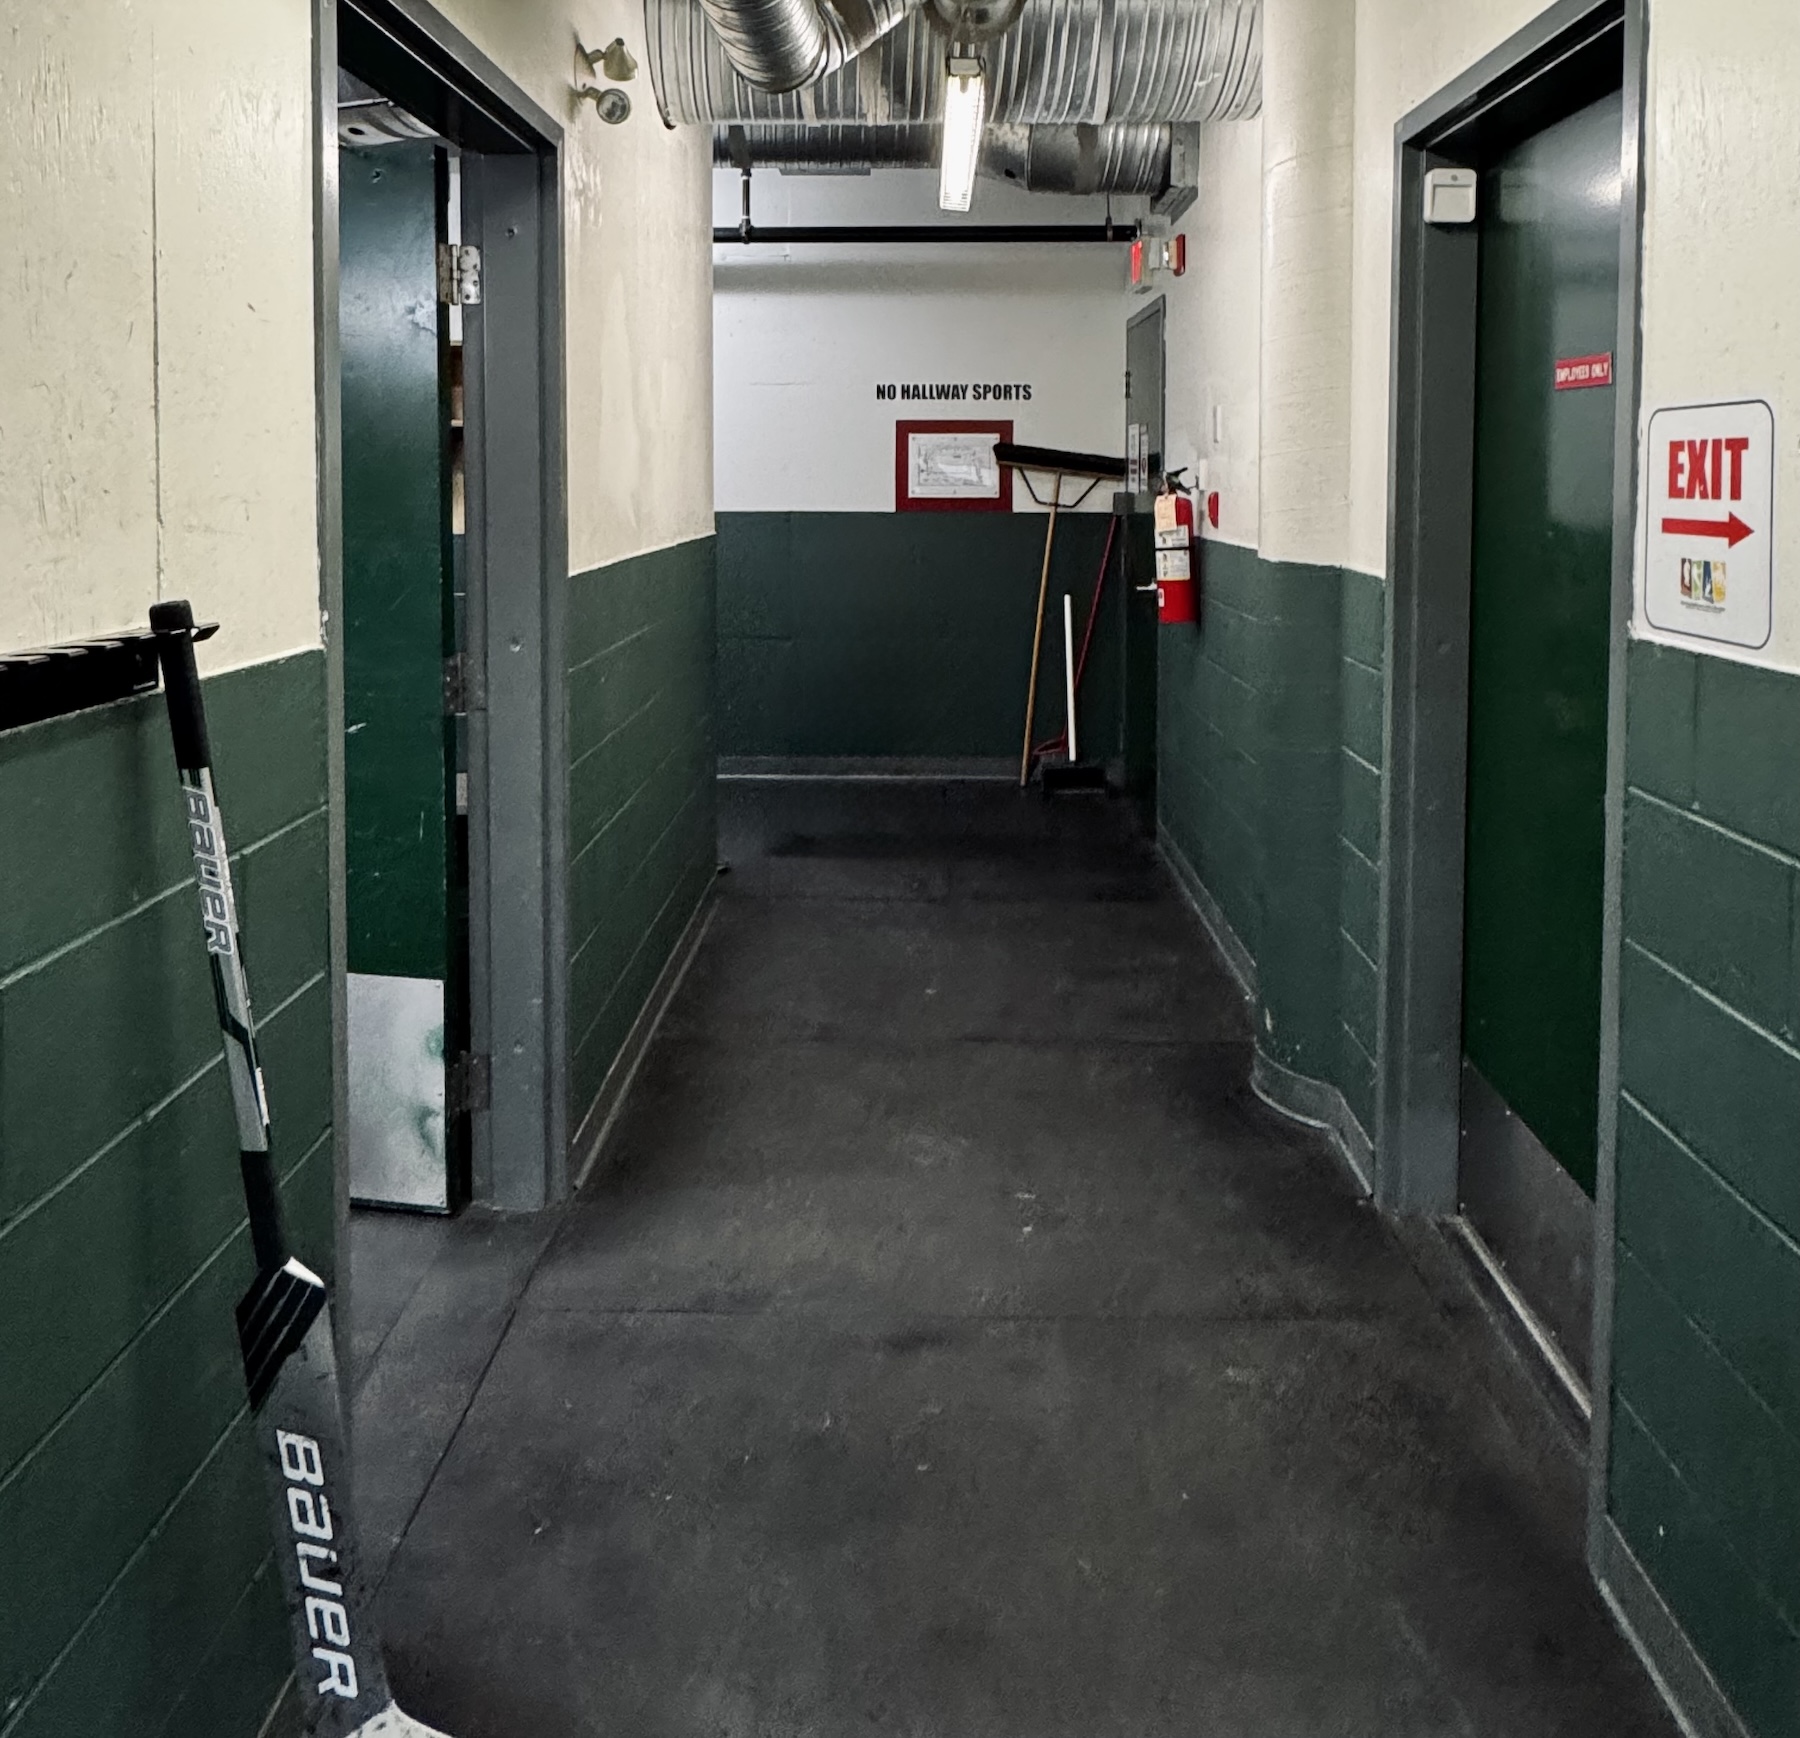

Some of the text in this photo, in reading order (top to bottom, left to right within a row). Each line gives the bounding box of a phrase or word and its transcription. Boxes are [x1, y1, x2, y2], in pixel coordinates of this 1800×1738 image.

[1556, 362, 1609, 382] EMPLOYEES ONLY
[876, 384, 1032, 400] NO HALLWAY SPORTS
[1668, 437, 1749, 501] EXIT
